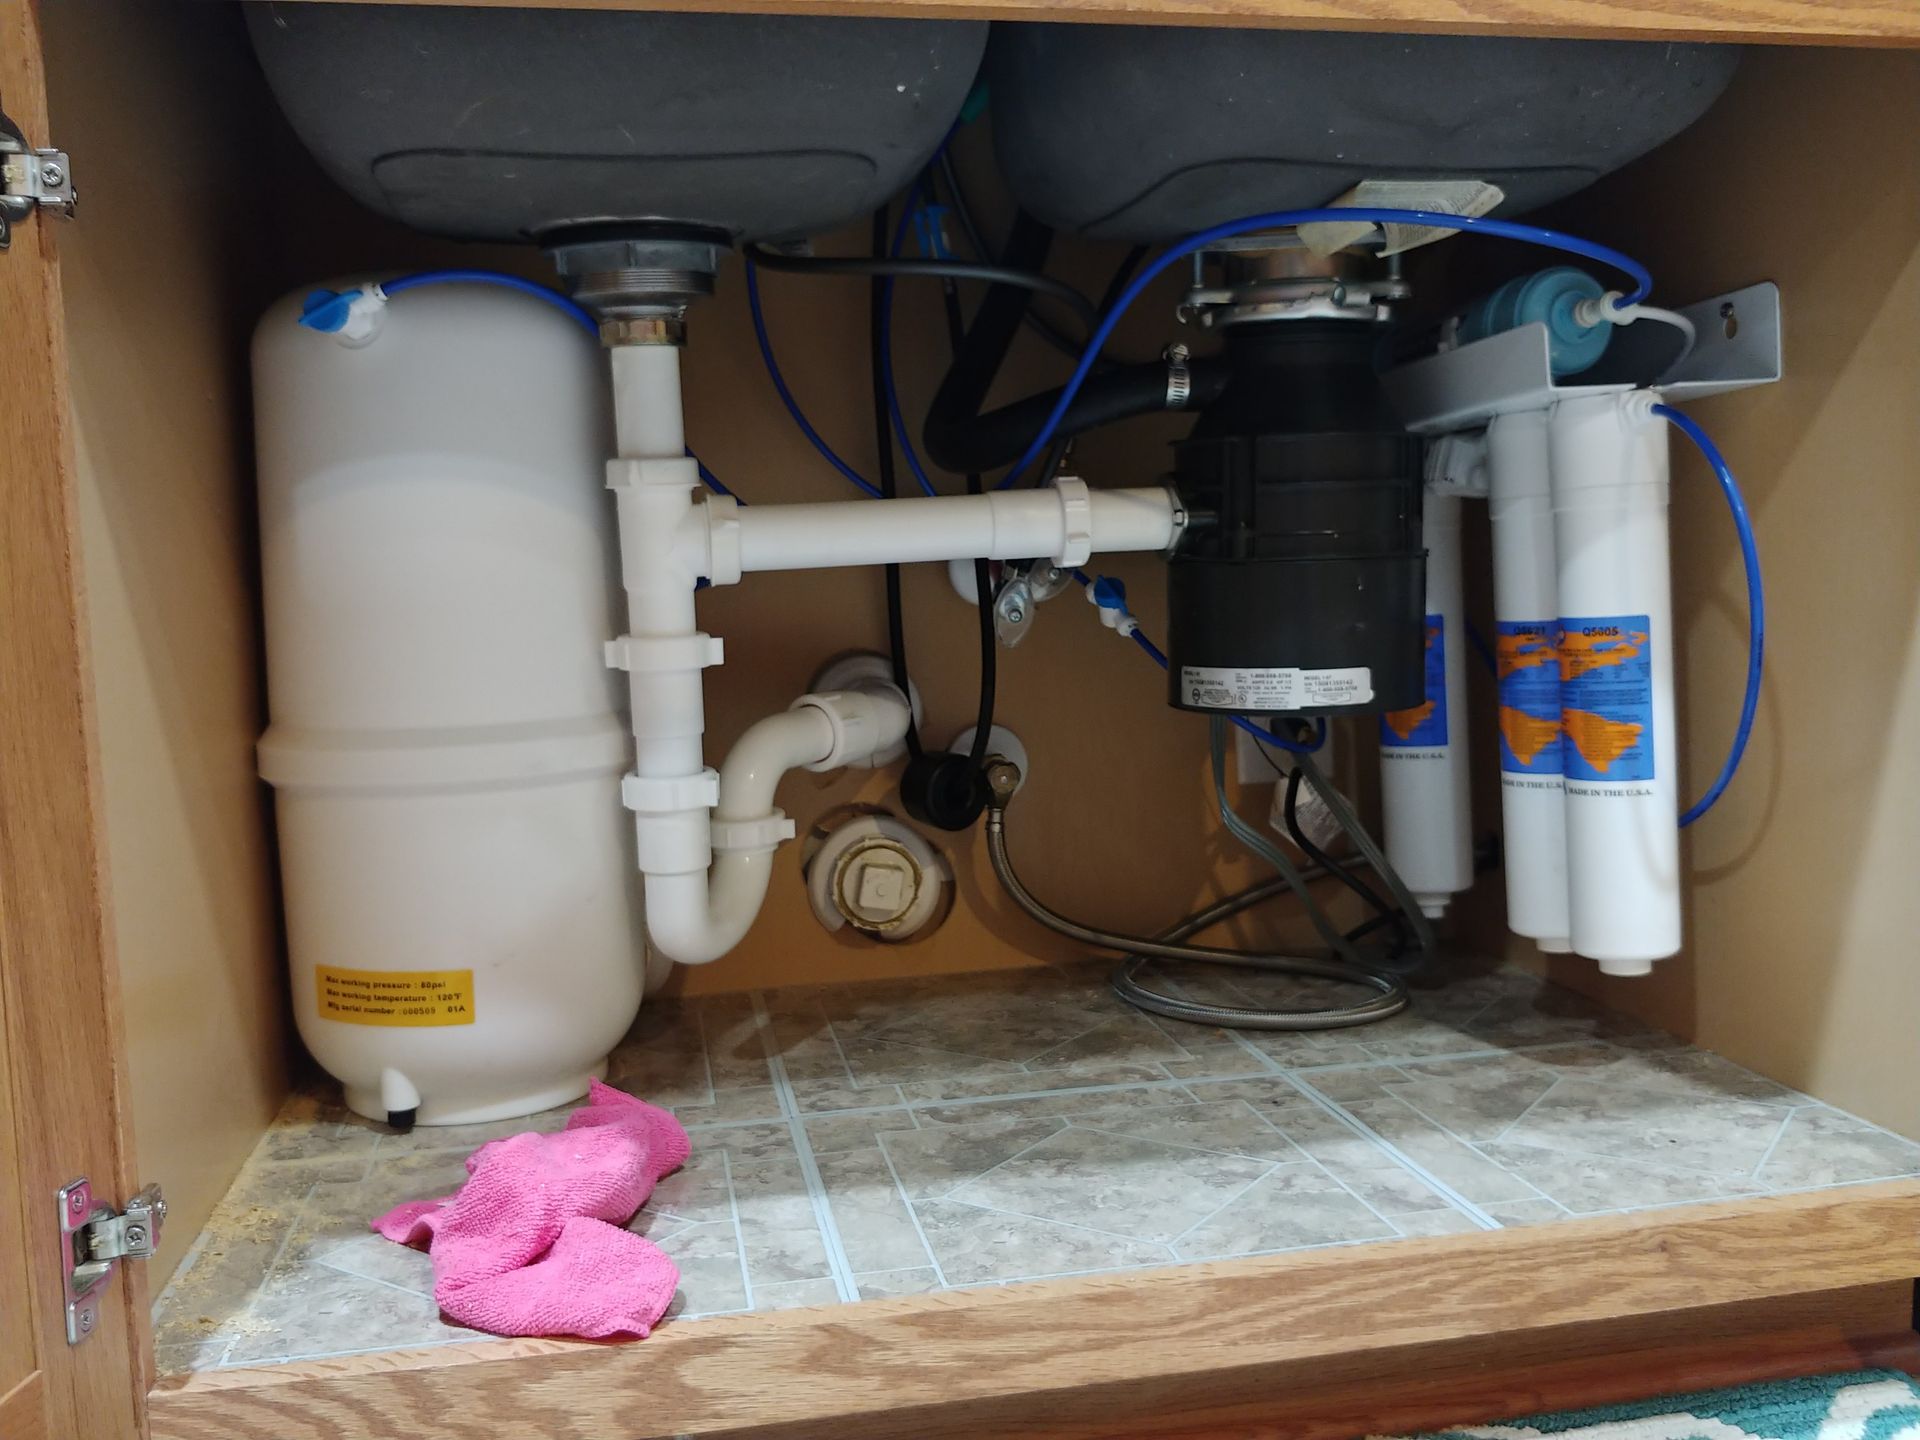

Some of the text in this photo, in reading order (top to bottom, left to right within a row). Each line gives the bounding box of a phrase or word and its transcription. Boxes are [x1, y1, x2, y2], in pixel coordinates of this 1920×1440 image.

[1526, 781, 1545, 789] THE
[1568, 787, 1654, 798] MADE IN THE U.S.A.
[341, 978, 371, 990] working
[373, 981, 411, 991] pressure
[342, 991, 372, 1002] working
[374, 993, 427, 1004] temperature
[364, 1006, 396, 1015] number
